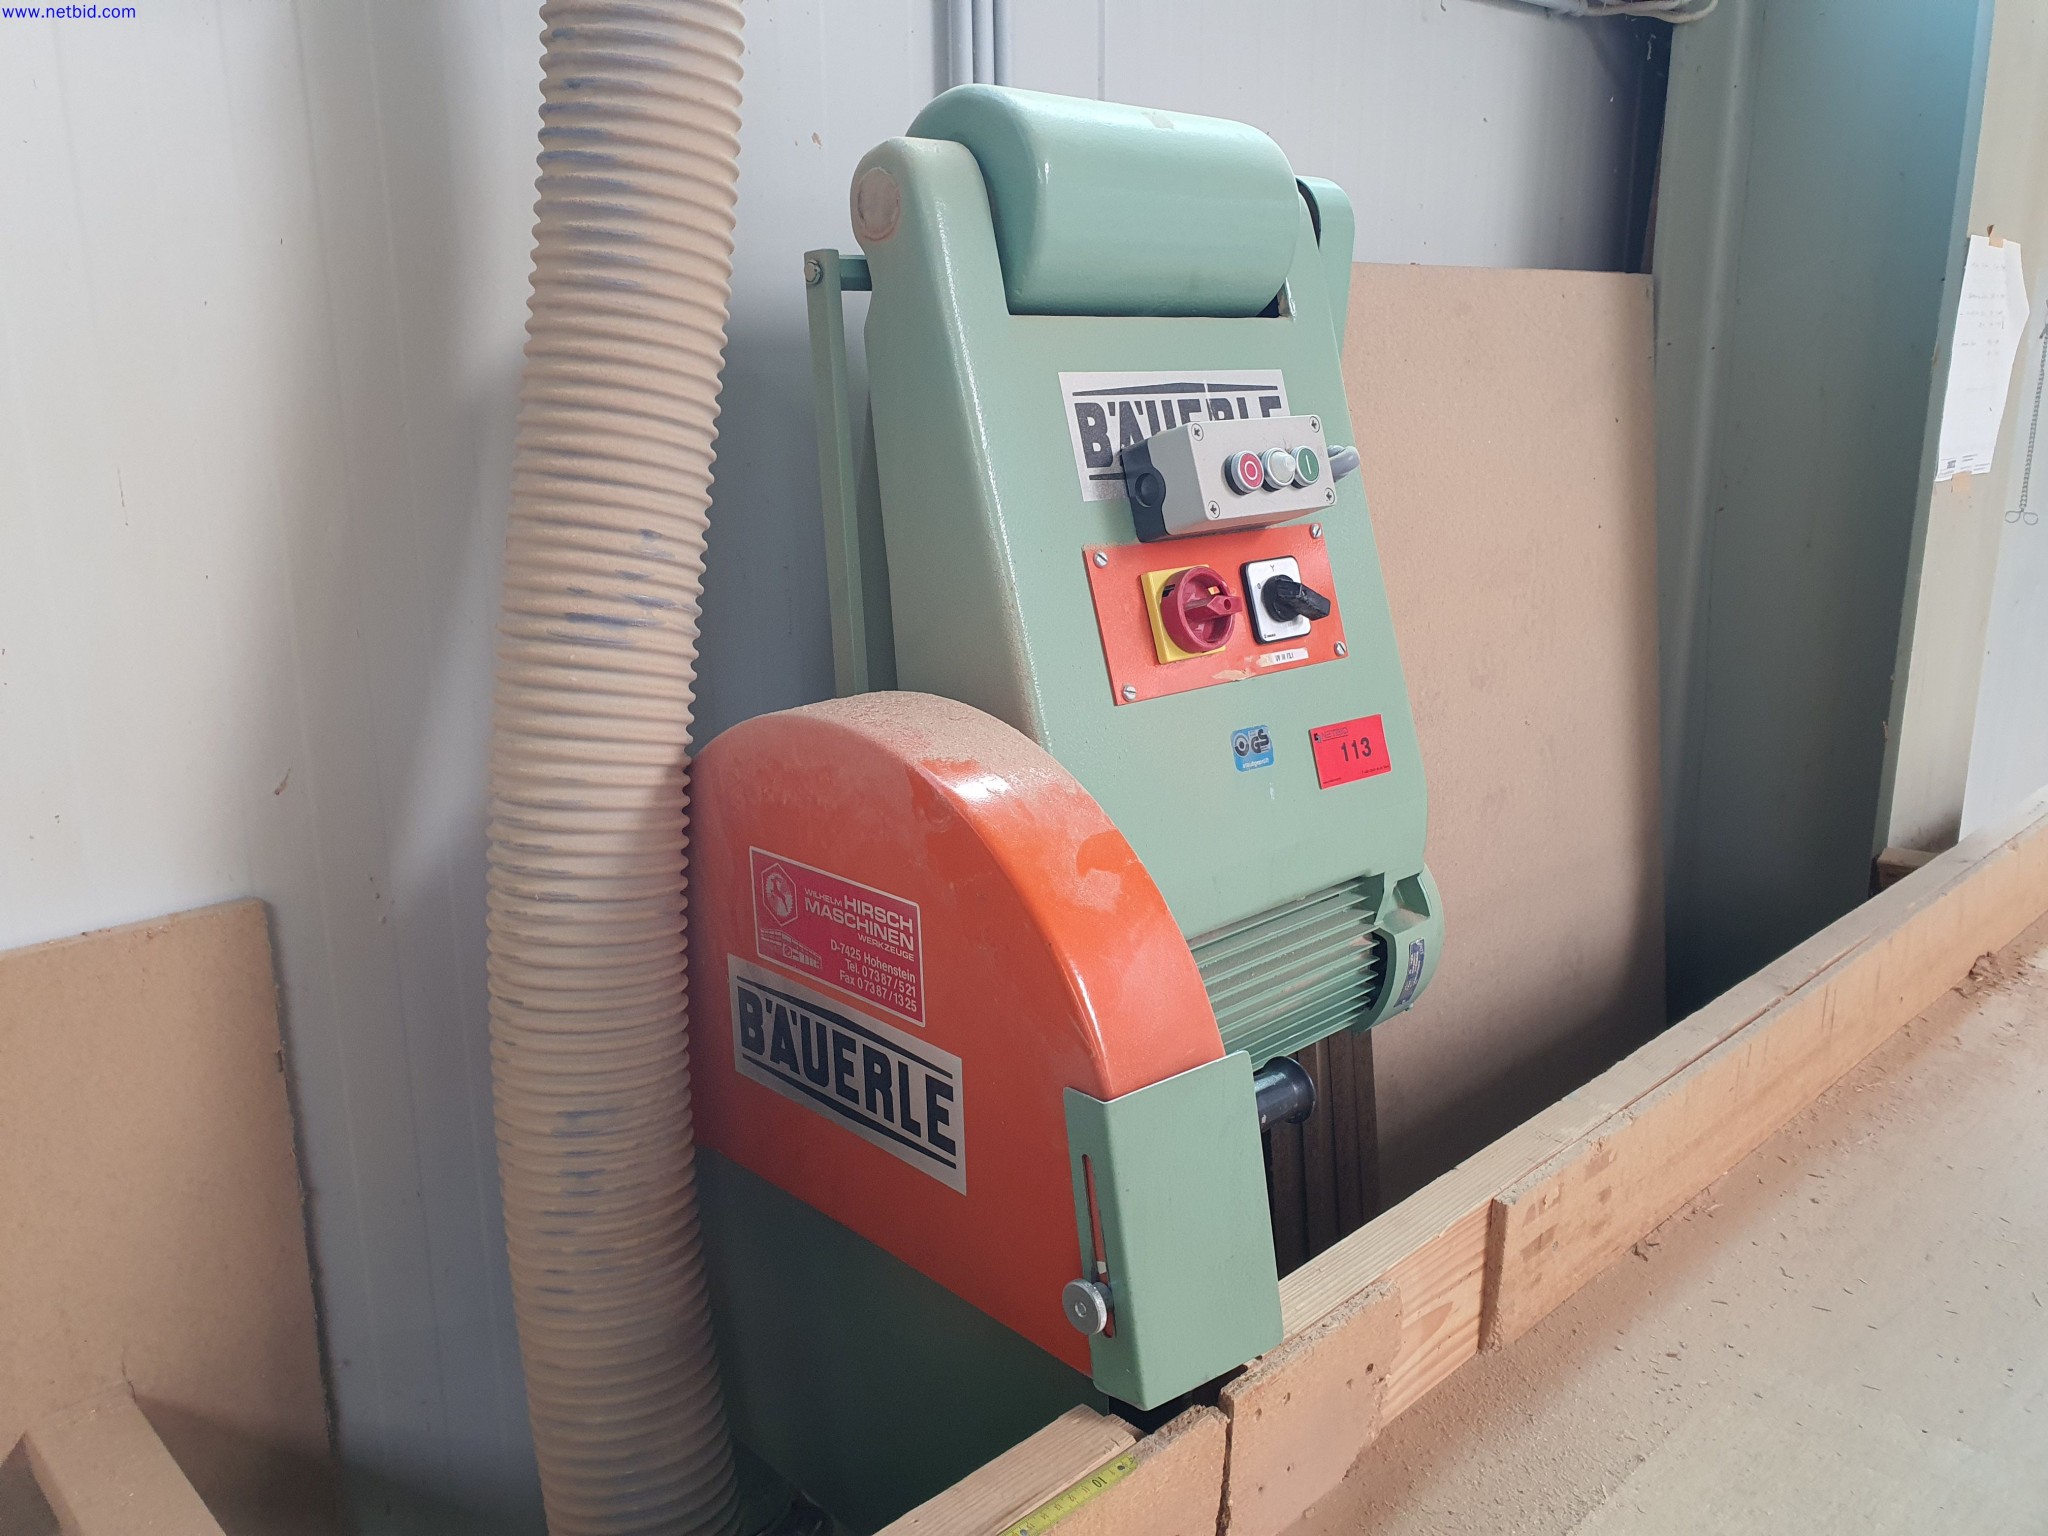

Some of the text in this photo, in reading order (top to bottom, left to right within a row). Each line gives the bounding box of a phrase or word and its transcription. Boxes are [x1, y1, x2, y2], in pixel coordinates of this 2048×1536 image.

[1341, 736, 1372, 762] 113
[804, 887, 913, 933] WILHELM HIRSCH
[804, 897, 914, 951] MASCHINEN
[830, 938, 916, 984] D-7425 Hohenstein
[857, 932, 915, 962] WERKZEUGE
[839, 969, 856, 986] Fax
[844, 958, 860, 974] Tel.
